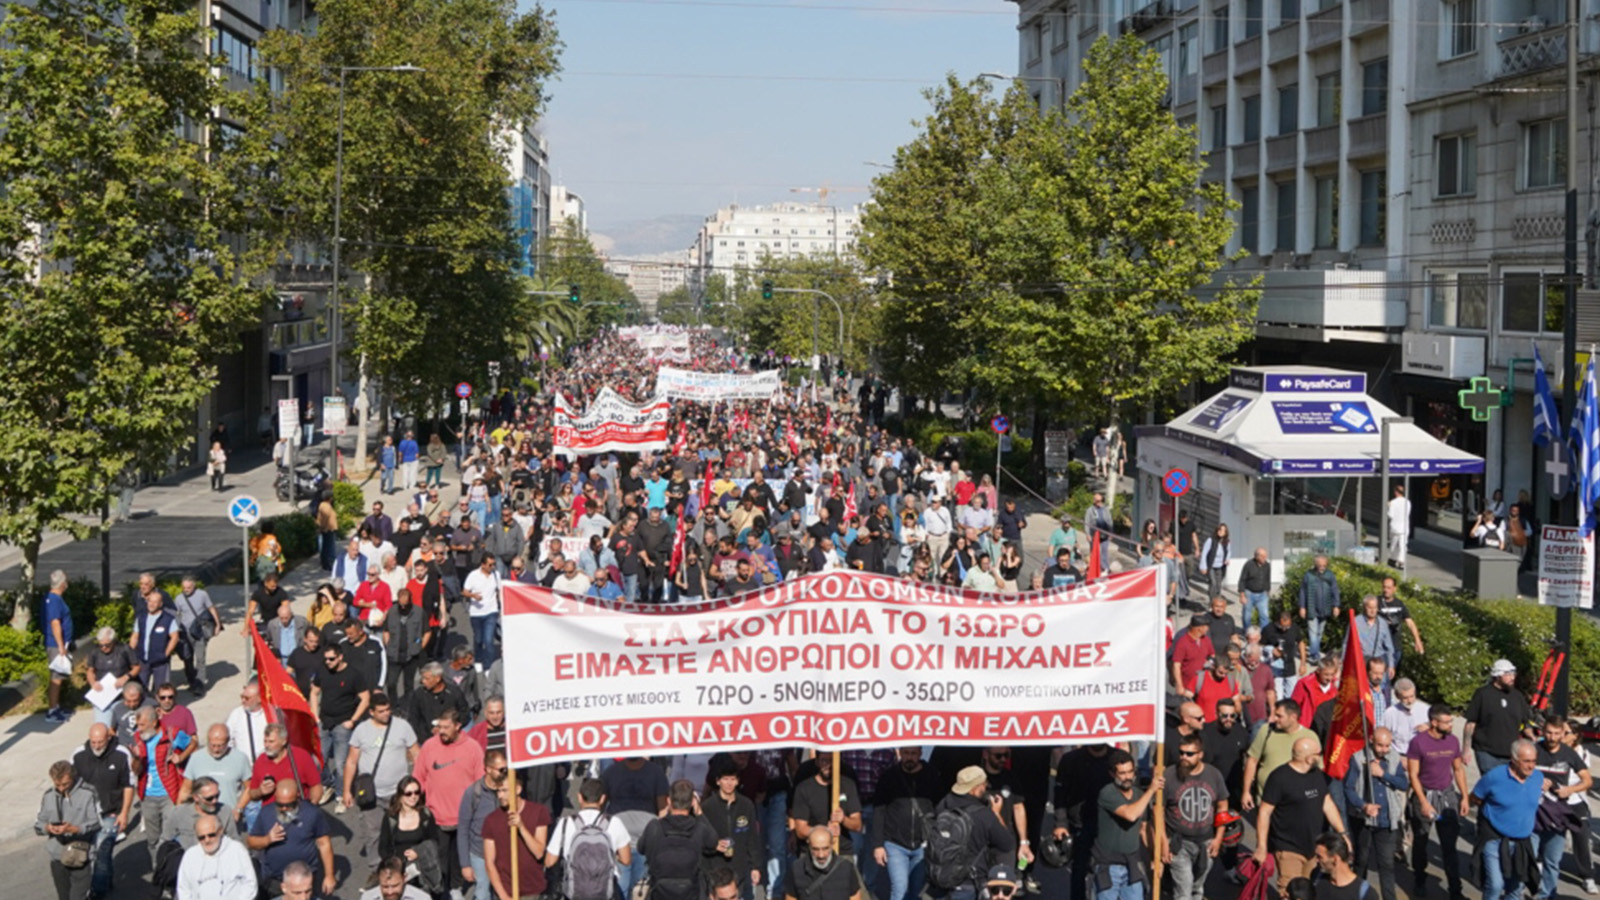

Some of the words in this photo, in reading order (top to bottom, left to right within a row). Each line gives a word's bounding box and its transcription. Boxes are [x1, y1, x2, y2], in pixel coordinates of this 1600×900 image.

[1295, 379, 1352, 390] PaysafeCard
[1545, 544, 1587, 555] ΑΠΕΡΓΙΑ
[1546, 528, 1585, 542] ΠΑΜ
[759, 575, 964, 605] ΟΙΚΟΔΟΜΩΝ
[624, 622, 688, 647] ΣΤΑ
[698, 608, 874, 645] ΣΚΟΥΠΙΔΙΑ
[882, 609, 927, 635] ΤΟ
[938, 613, 1046, 638] 13ΩΡΟ
[554, 652, 698, 681] ΕΙΜΑΣΤΕ
[708, 644, 880, 674] ΑΝΘΡΩΠΟΙ
[890, 644, 944, 671] ΟΧΙ
[955, 641, 1113, 670] ΜΗΧΑΝΕΣ
[522, 697, 581, 714] ΑΥΞΗΣΕΙΣ
[584, 694, 624, 708] ΣΤΟΥΣ
[626, 691, 681, 706] ΜΙΣΘΟΥΣ
[696, 684, 754, 706] 7ΩΡΟ
[773, 680, 886, 704] 5ΝΘΗΜΕΡΟ
[905, 681, 976, 702] 35ΩΡΟ
[984, 682, 1101, 699] ΥΠΟΧΡΕΩΤΙΚΟΤΗΤΑ
[1105, 682, 1126, 696] ΤΗΣ
[1128, 679, 1149, 693] ΣΣΕ
[525, 715, 758, 756] ΟΜΟΣΠΟΝΔΙΑ
[769, 714, 970, 741] ΟΙΚΟΔΟΜΩΝ
[984, 710, 1130, 737] ΕΛΛΑΔΑΣ
